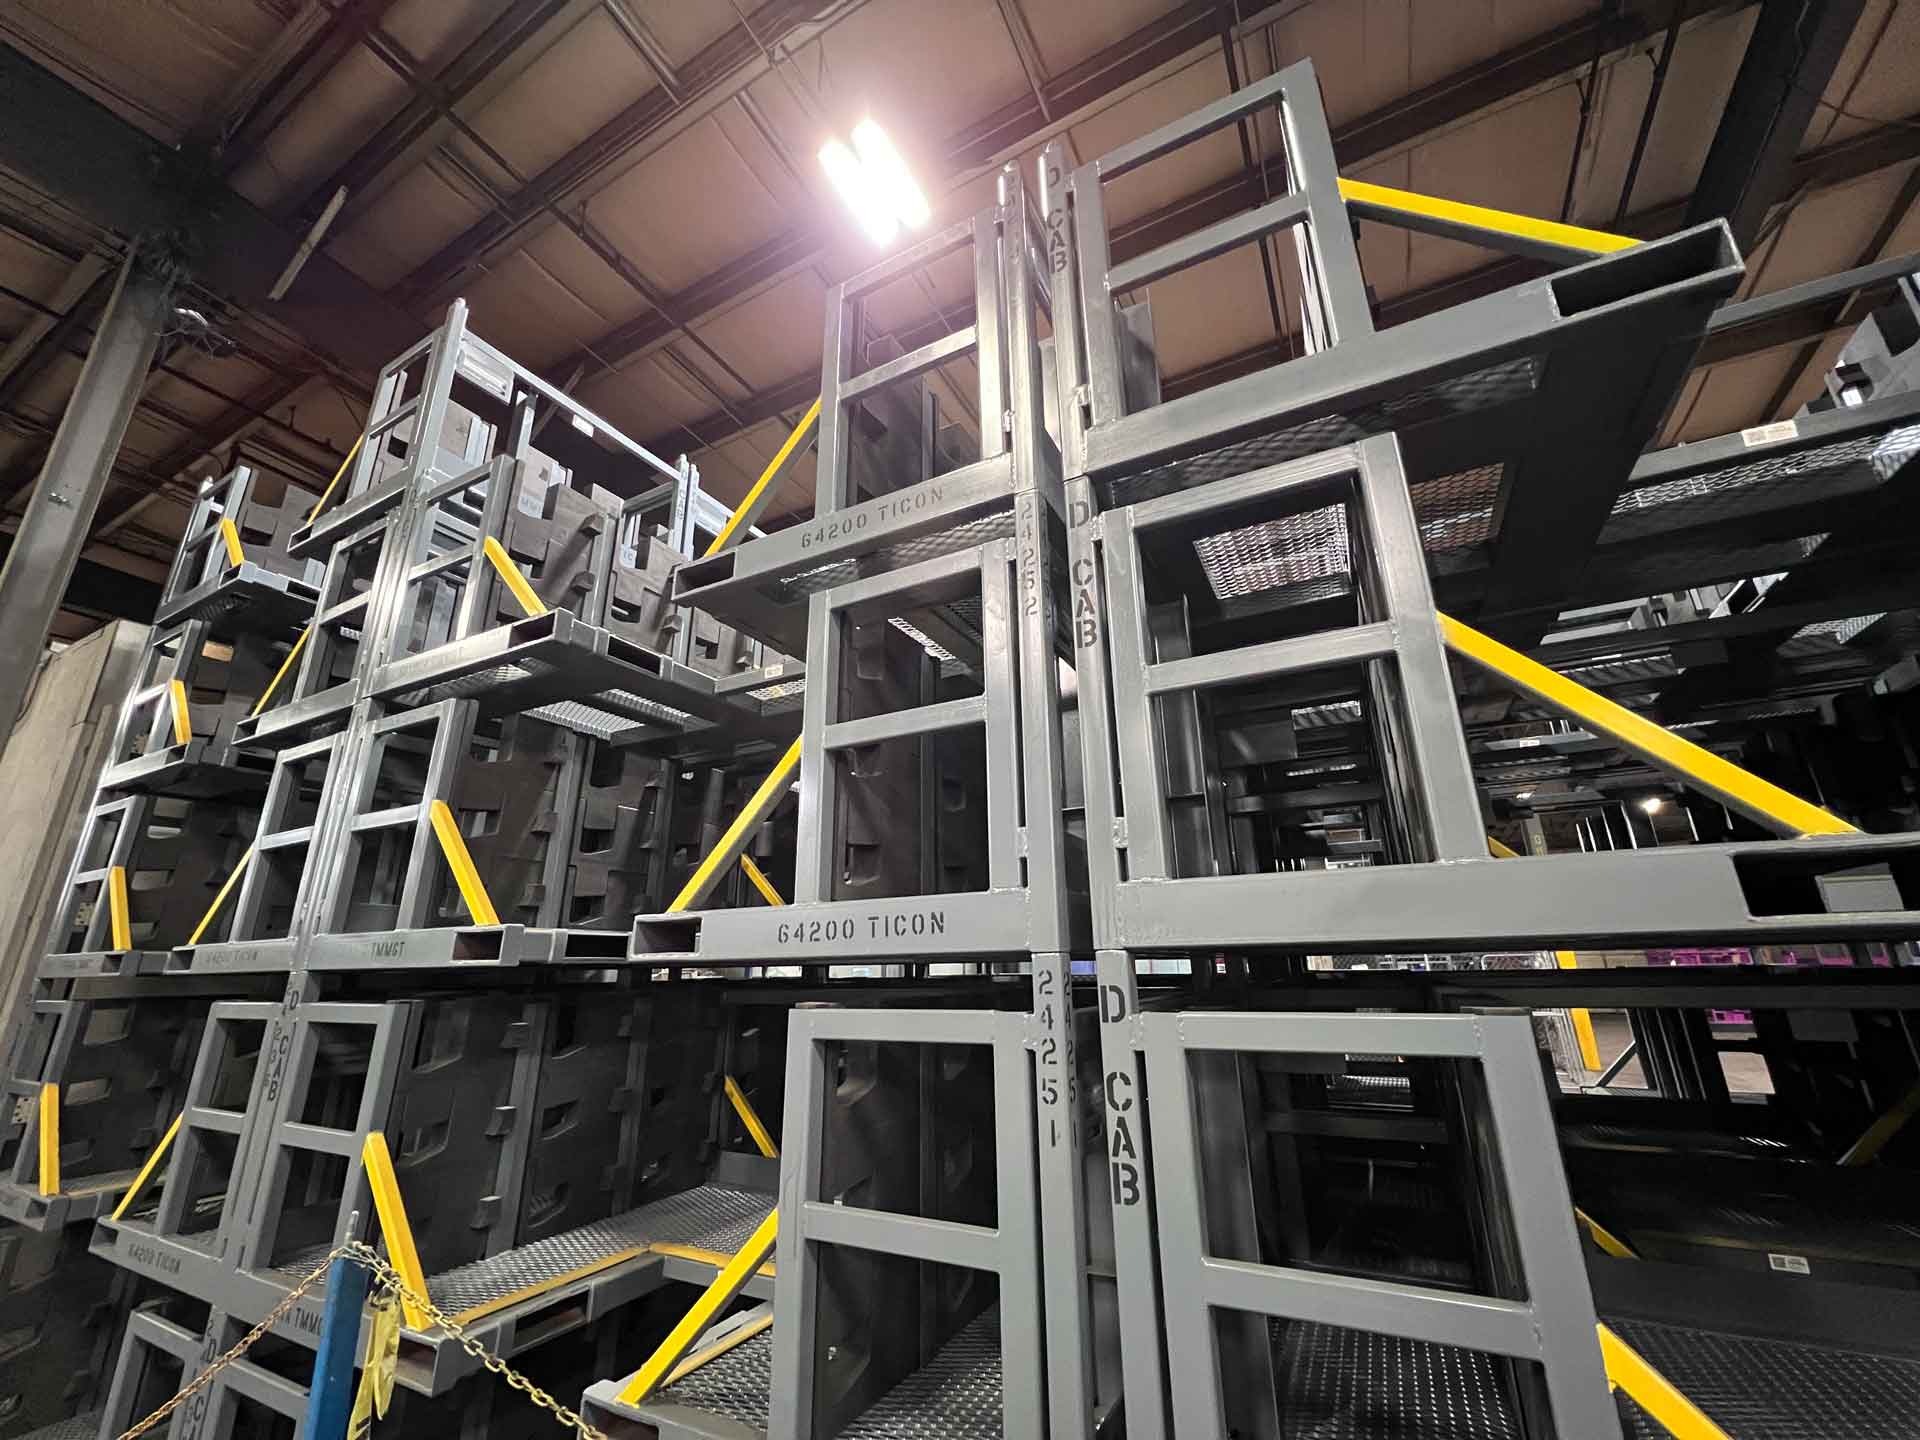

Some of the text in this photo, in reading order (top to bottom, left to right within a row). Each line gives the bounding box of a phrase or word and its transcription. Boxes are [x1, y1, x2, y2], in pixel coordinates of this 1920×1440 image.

[1048, 208, 1068, 274] CAB
[800, 487, 944, 549] 64200 TICON
[1069, 501, 1098, 649] D CAB
[778, 911, 945, 944] 64200 TICON
[267, 990, 300, 1101] D CAB
[1038, 969, 1058, 1148] 24251
[1099, 984, 1141, 1206] D CAB
[295, 1307, 324, 1338] TMM
